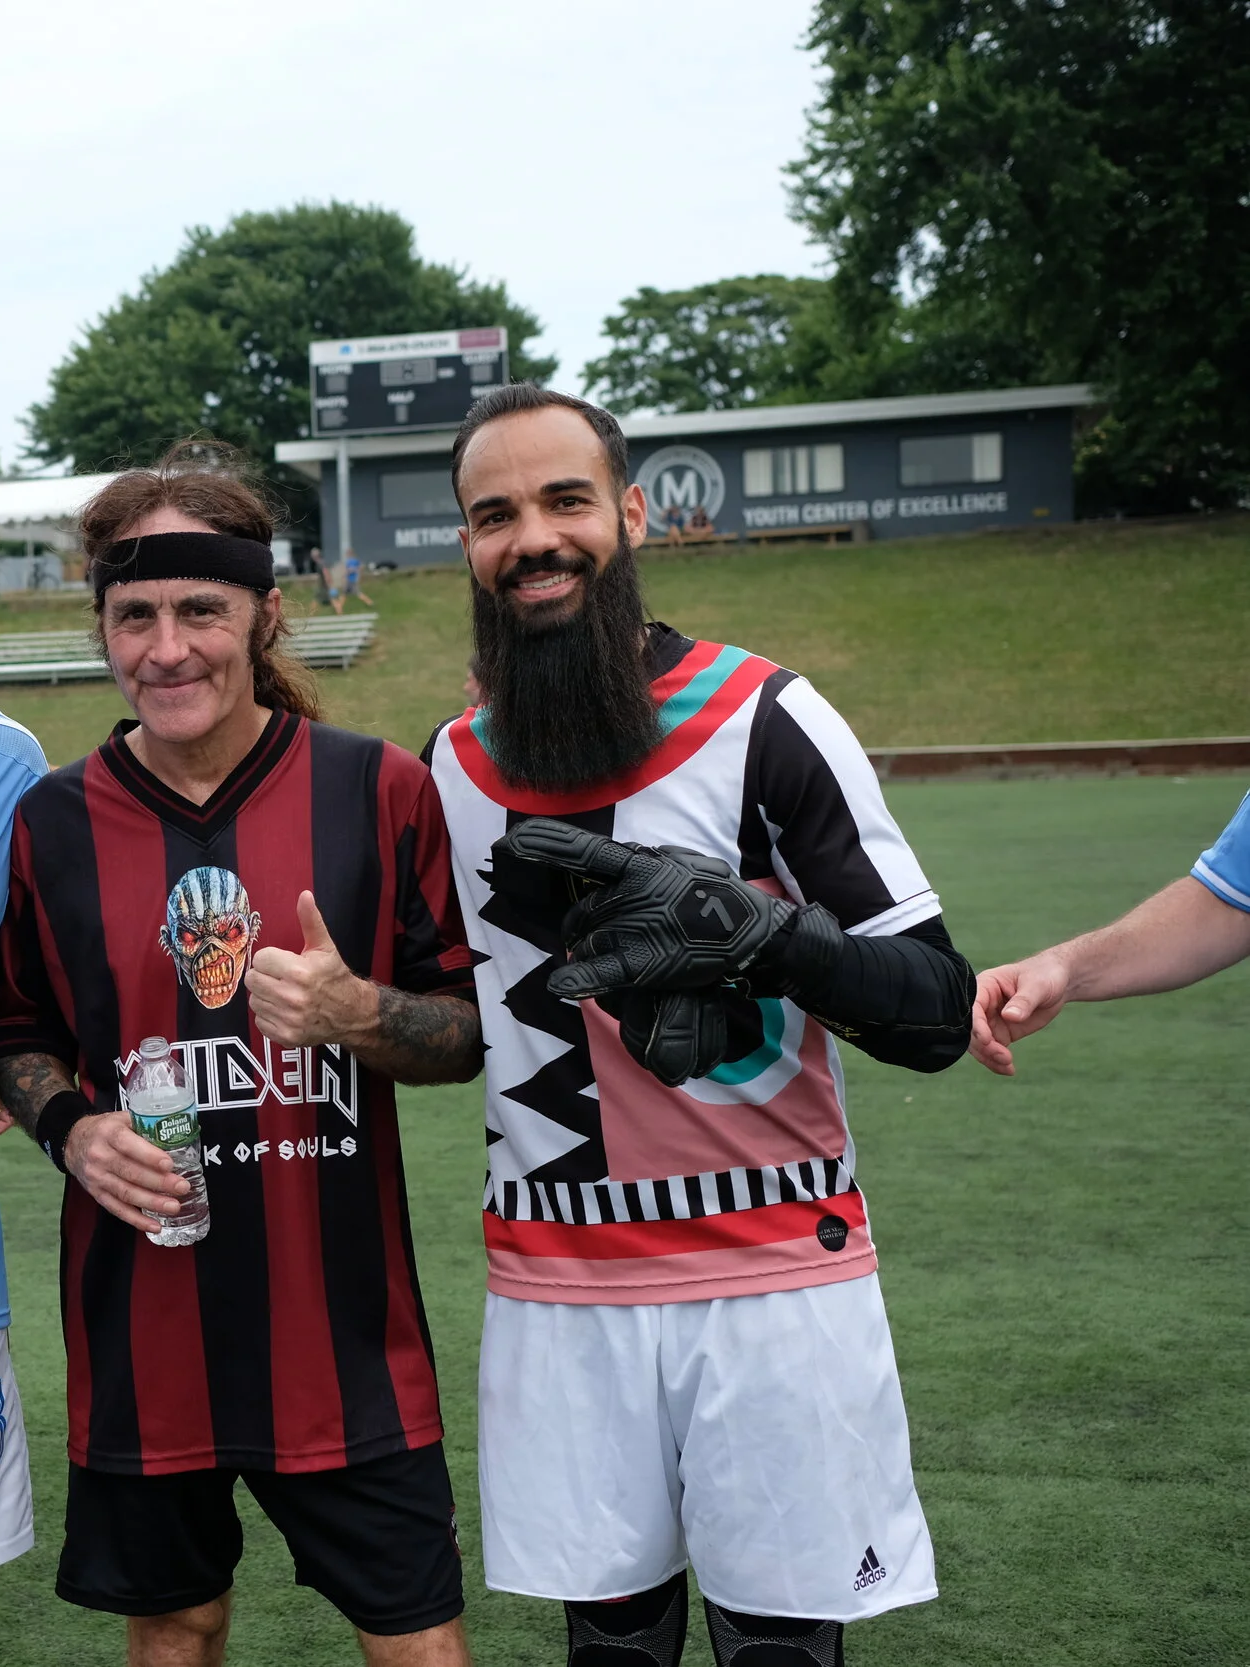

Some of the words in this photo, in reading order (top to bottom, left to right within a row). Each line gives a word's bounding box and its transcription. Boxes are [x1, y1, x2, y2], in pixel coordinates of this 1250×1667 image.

[661, 469, 698, 509] M
[742, 504, 800, 527] YOUTH
[801, 501, 869, 524] CENTER
[871, 499, 896, 520] OF
[899, 492, 1008, 518] EXCELLENCE
[159, 1122, 192, 1141] Spring
[161, 1115, 188, 1129] Poland
[234, 1140, 270, 1163] OF
[278, 1136, 357, 1161] SOULS
[853, 1567, 886, 1591] adidas
